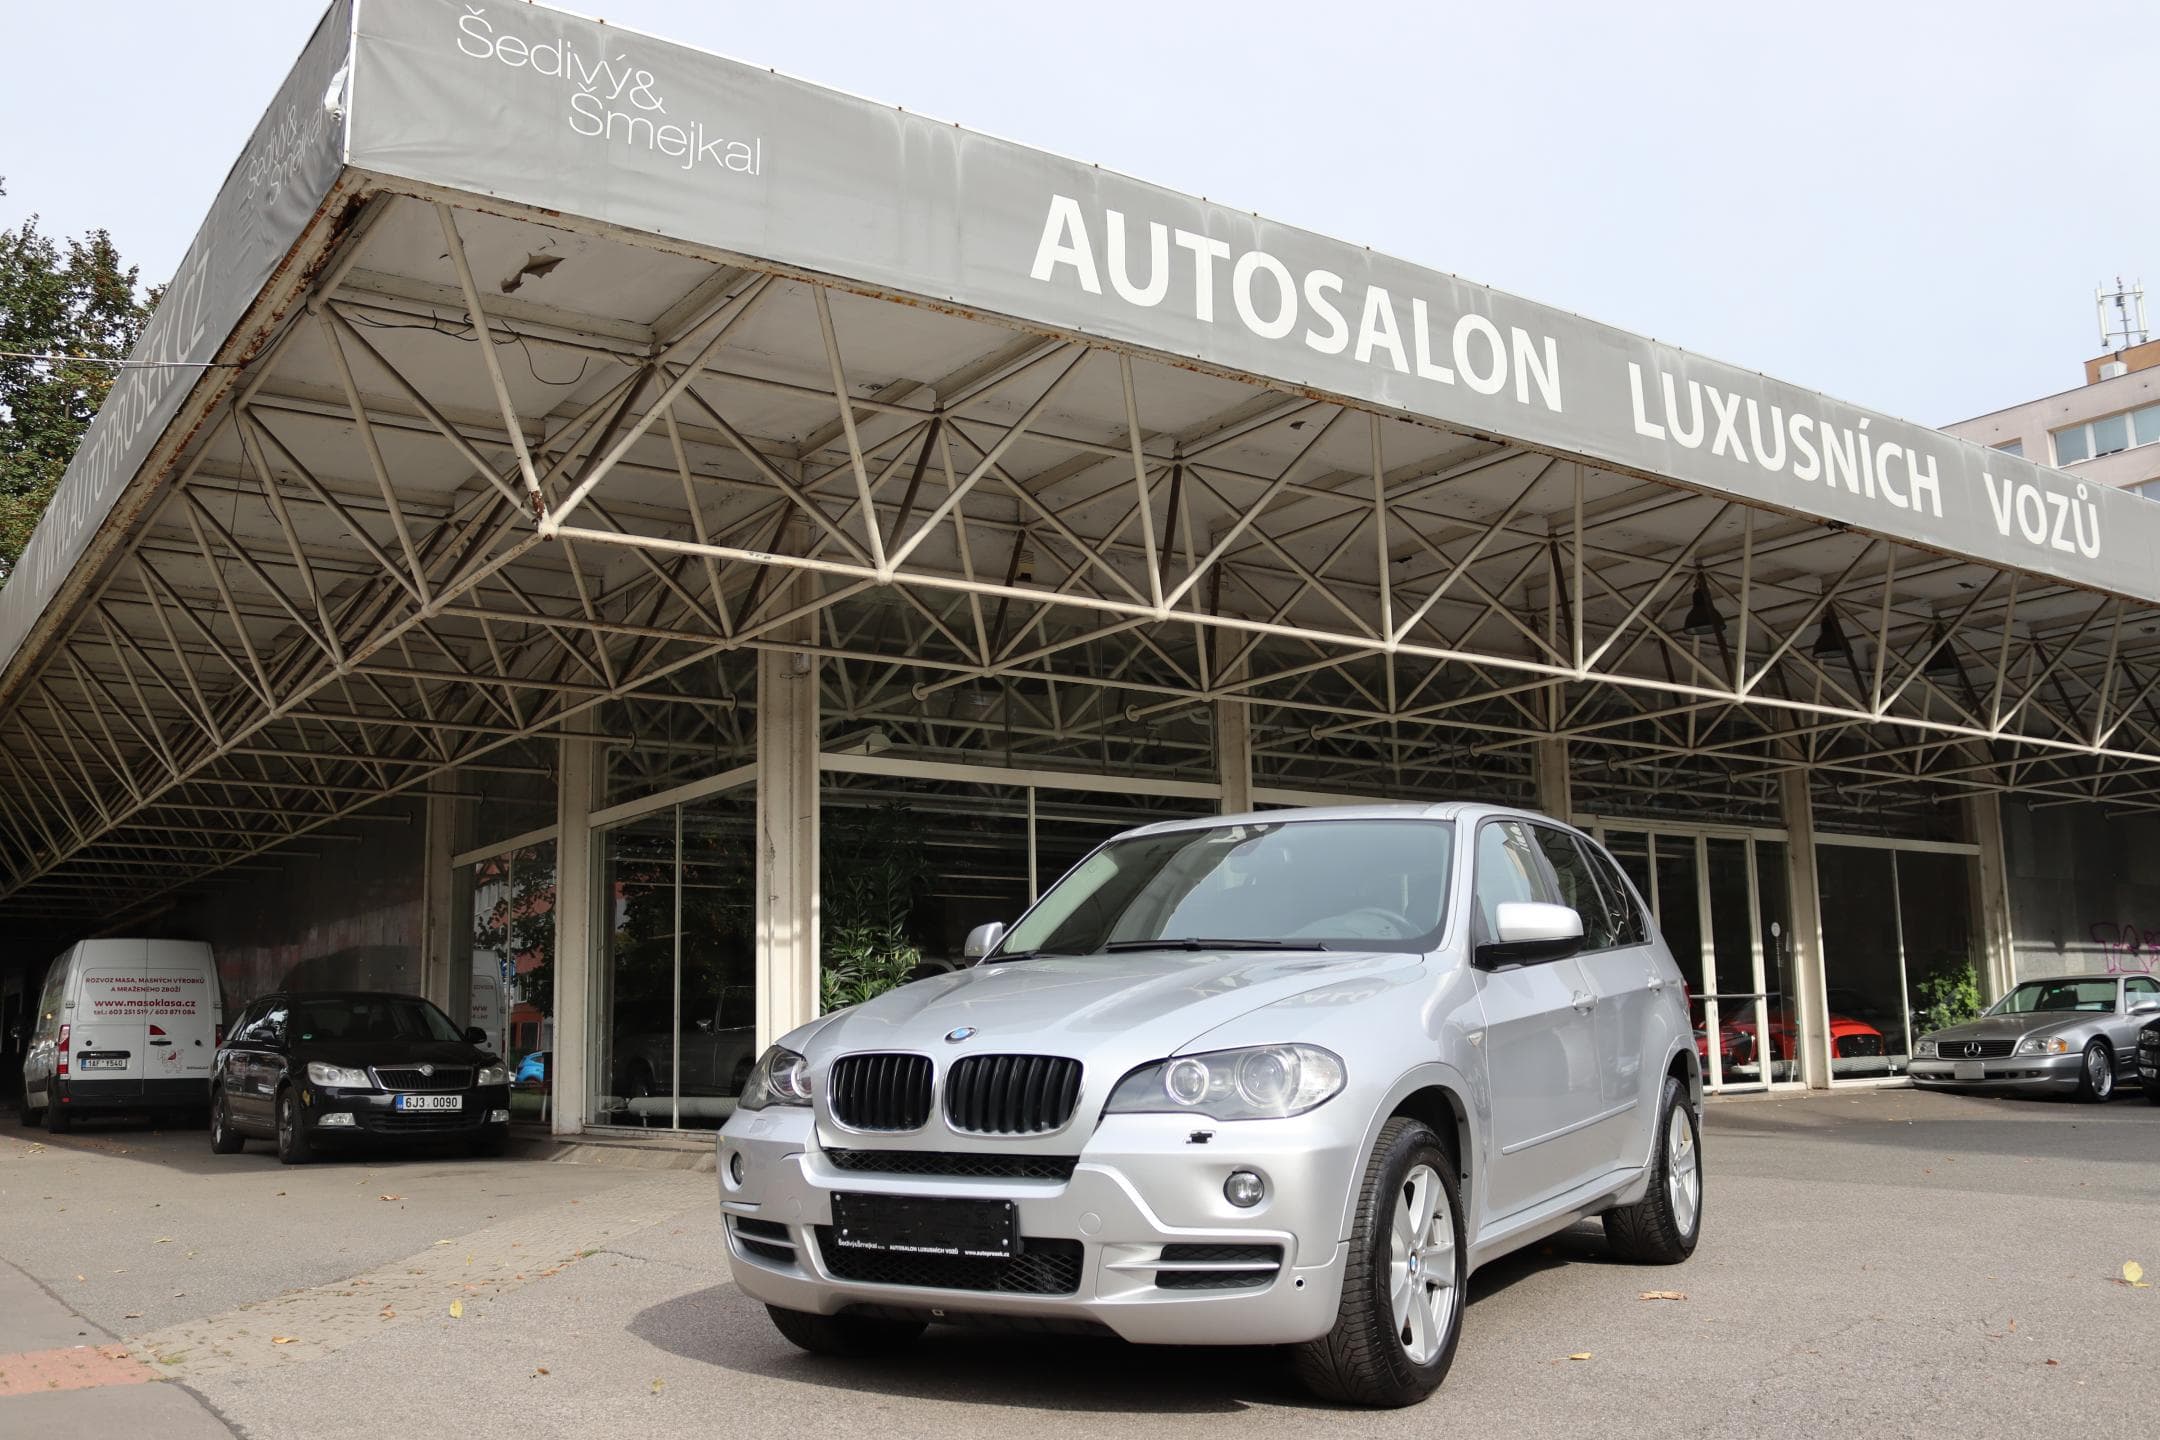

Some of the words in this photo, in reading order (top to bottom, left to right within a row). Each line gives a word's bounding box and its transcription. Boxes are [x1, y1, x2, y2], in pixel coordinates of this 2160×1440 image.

[568, 82, 762, 176] Šmejkal
[1029, 193, 1563, 413] AUTOSALON
[1627, 360, 1944, 519] LUXUSNÍCH
[1982, 470, 2101, 560] VOZŮ
[139, 976, 173, 984] MASNÝCH
[173, 976, 206, 985] VÝROBKŮ
[116, 985, 161, 993] MRAŽENÉHO
[94, 998, 197, 1007] www.masoklasa.cz
[405, 1097, 425, 1108] 6J3
[432, 1097, 458, 1108] 0090
